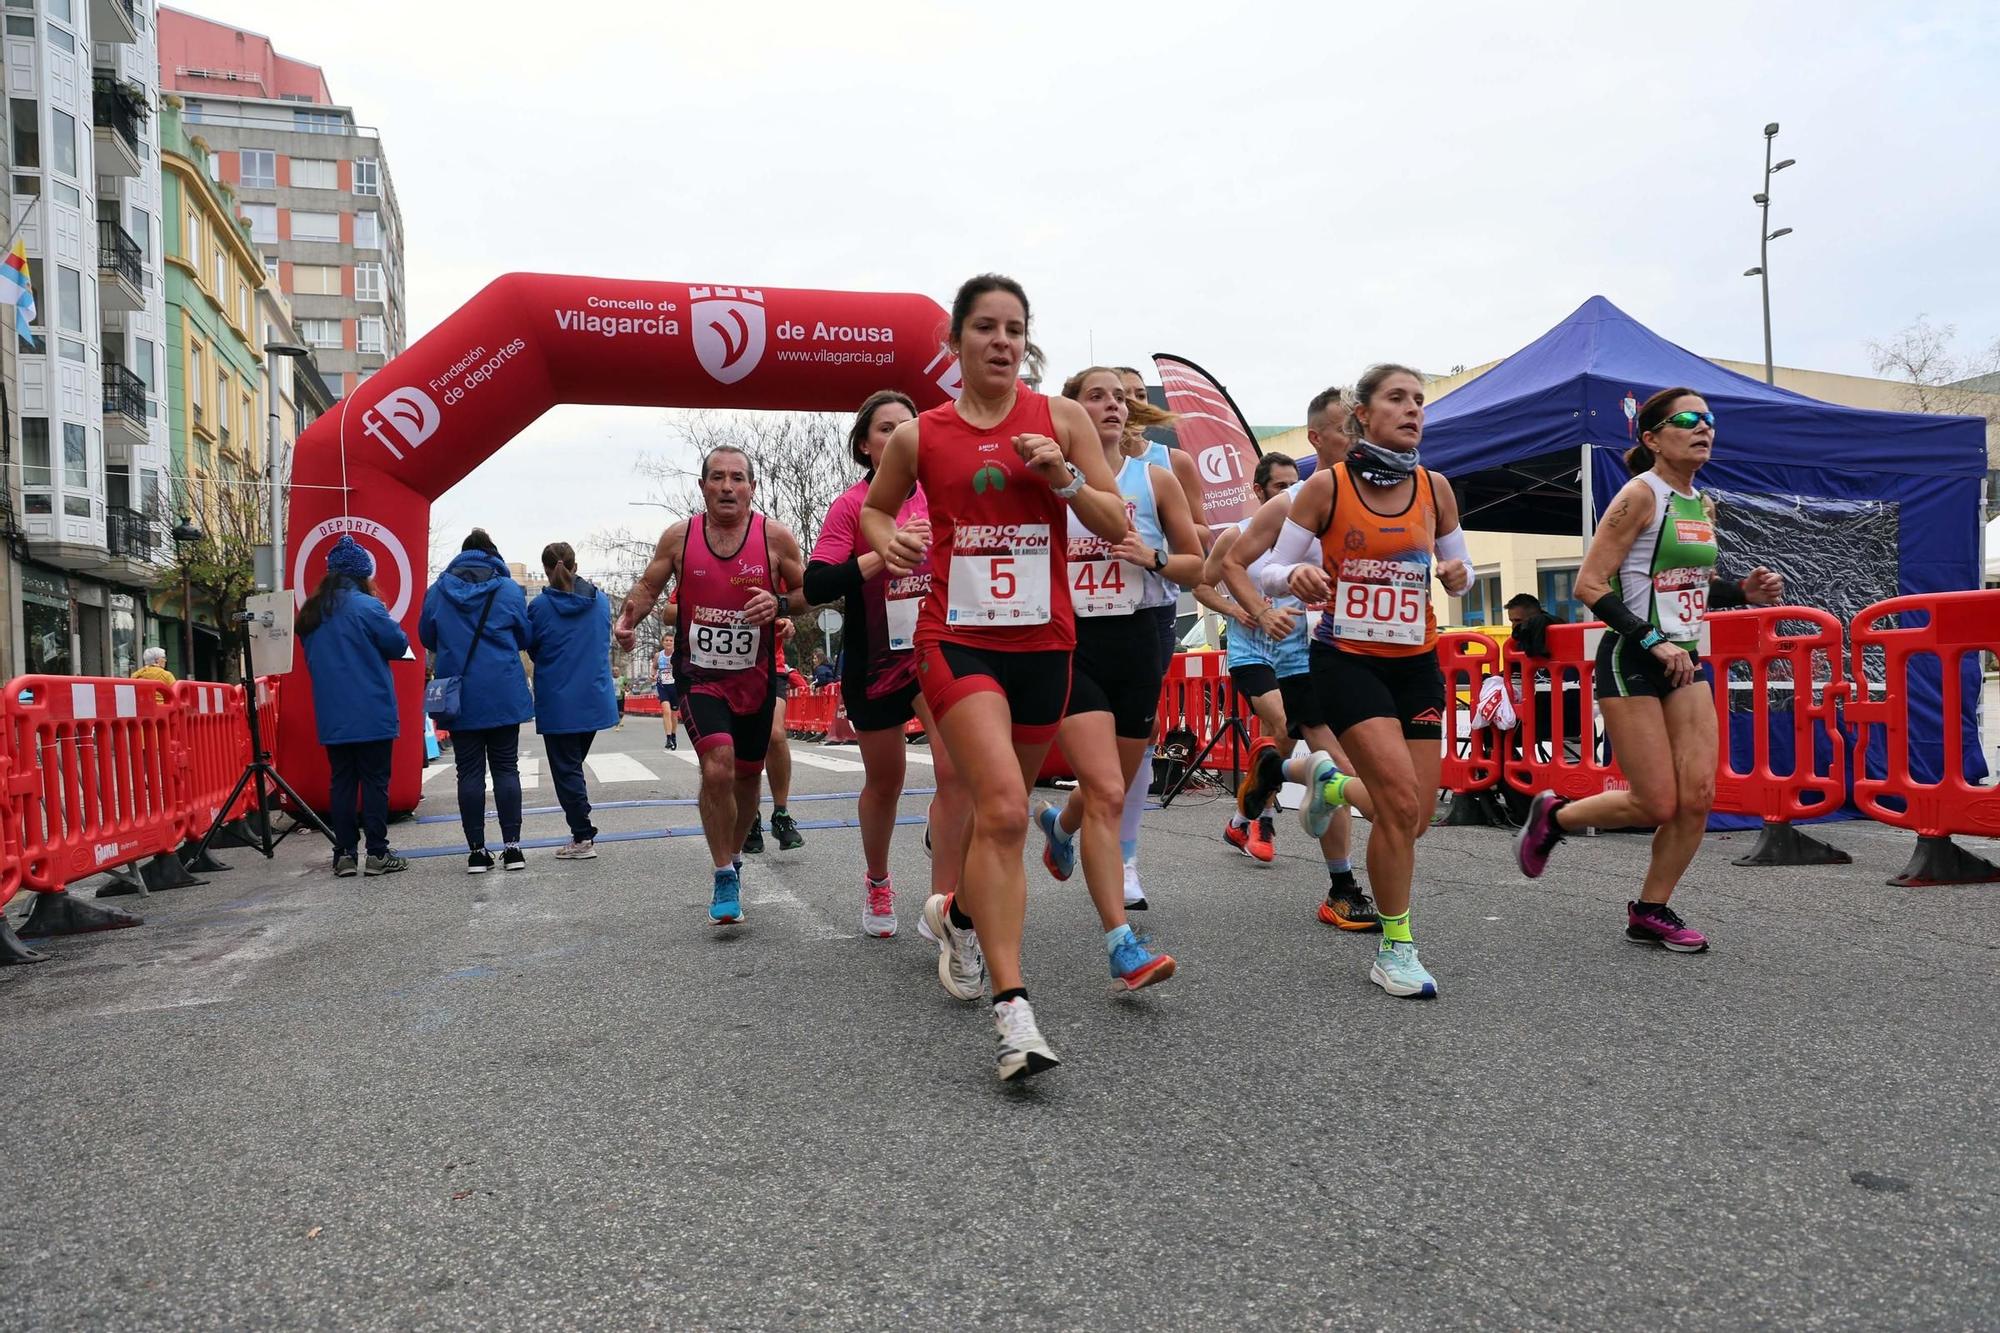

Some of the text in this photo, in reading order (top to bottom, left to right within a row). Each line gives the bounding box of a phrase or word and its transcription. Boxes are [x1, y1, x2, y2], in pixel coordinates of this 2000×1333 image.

[587, 296, 677, 312] Concello de
[554, 309, 679, 337] Vilagarcía
[776, 320, 894, 342] de Arousa
[777, 348, 895, 366] www.vilagarcia.gal
[428, 344, 486, 393] Fundación
[443, 336, 526, 406] de deportes
[318, 519, 380, 537] DEPORTE
[955, 525, 1019, 538] MEDIO
[954, 533, 1049, 549] MARATÓN
[1343, 559, 1402, 572] MEDIO
[990, 558, 1016, 599] 5
[1073, 561, 1126, 596] 44
[694, 605, 738, 618] MEDIO
[1345, 584, 1420, 624] 805
[697, 627, 753, 656] 833
